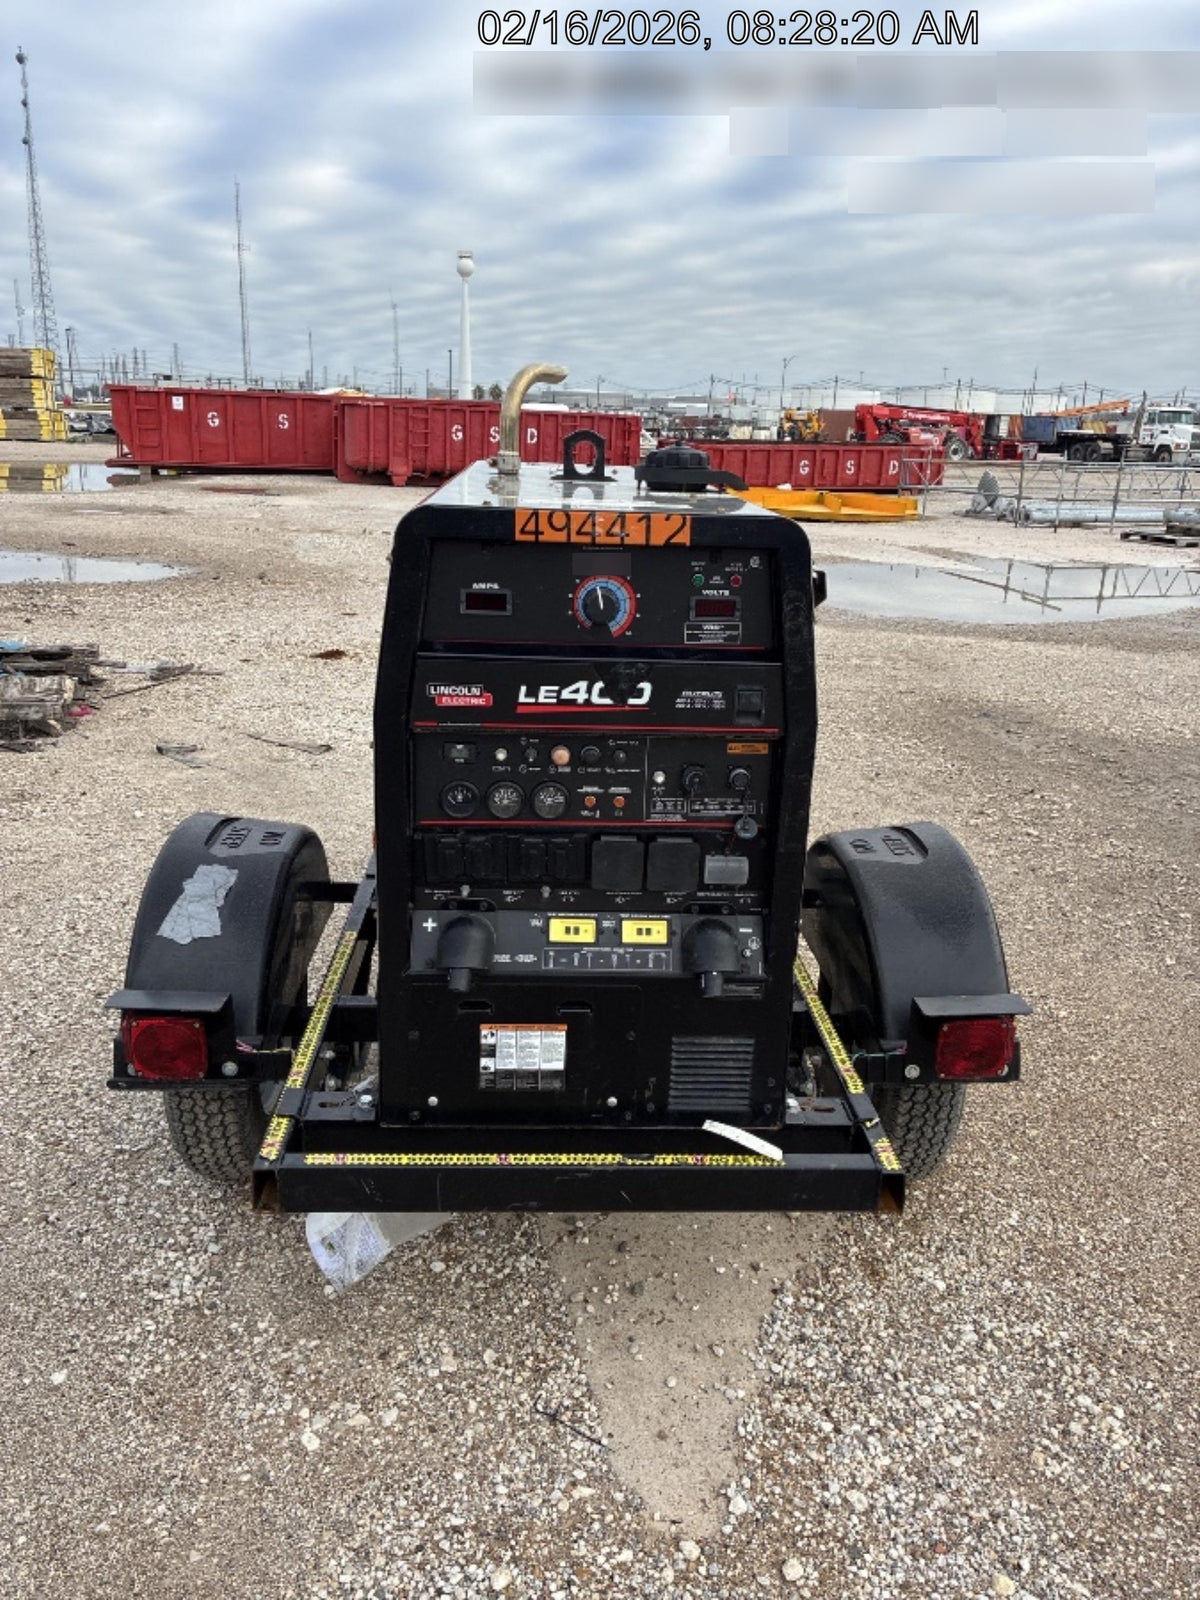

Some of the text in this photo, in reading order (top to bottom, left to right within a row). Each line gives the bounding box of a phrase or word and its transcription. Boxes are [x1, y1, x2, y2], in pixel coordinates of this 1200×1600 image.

[207, 411, 289, 429] G S
[451, 424, 538, 444] G S D
[799, 460, 899, 475] G S D
[519, 510, 688, 546] 494412
[430, 686, 481, 696] LINCOLN
[442, 696, 486, 705] ELECTRIC
